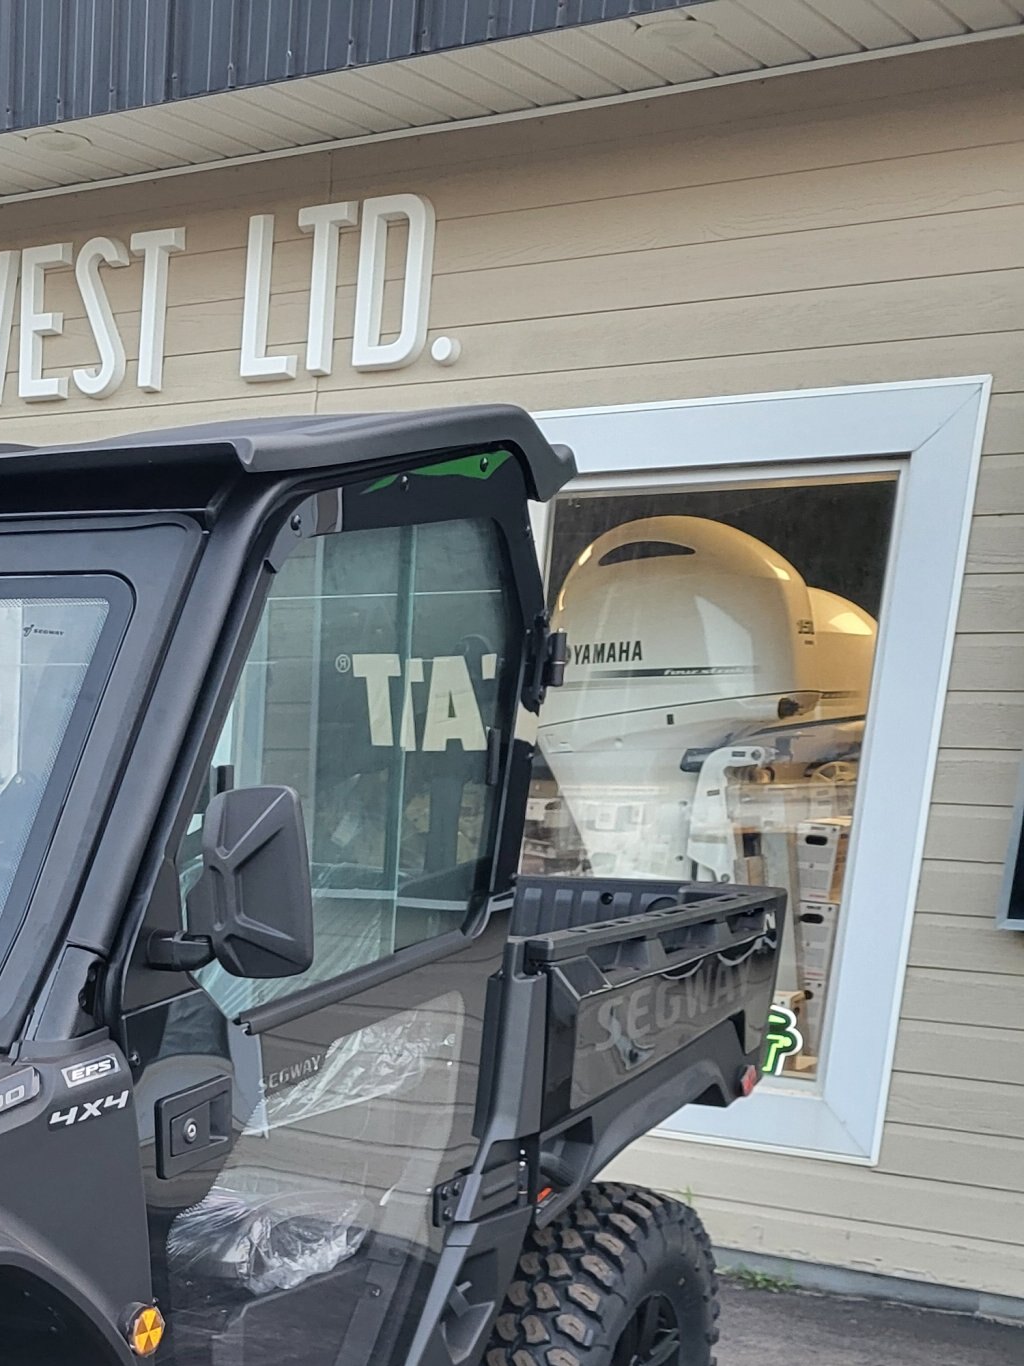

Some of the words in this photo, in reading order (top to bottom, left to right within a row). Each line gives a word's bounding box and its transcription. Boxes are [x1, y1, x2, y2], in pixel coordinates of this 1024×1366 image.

[240, 193, 462, 383] LTD.
[574, 641, 643, 665] YAMAHA
[70, 1059, 113, 1081] EPS
